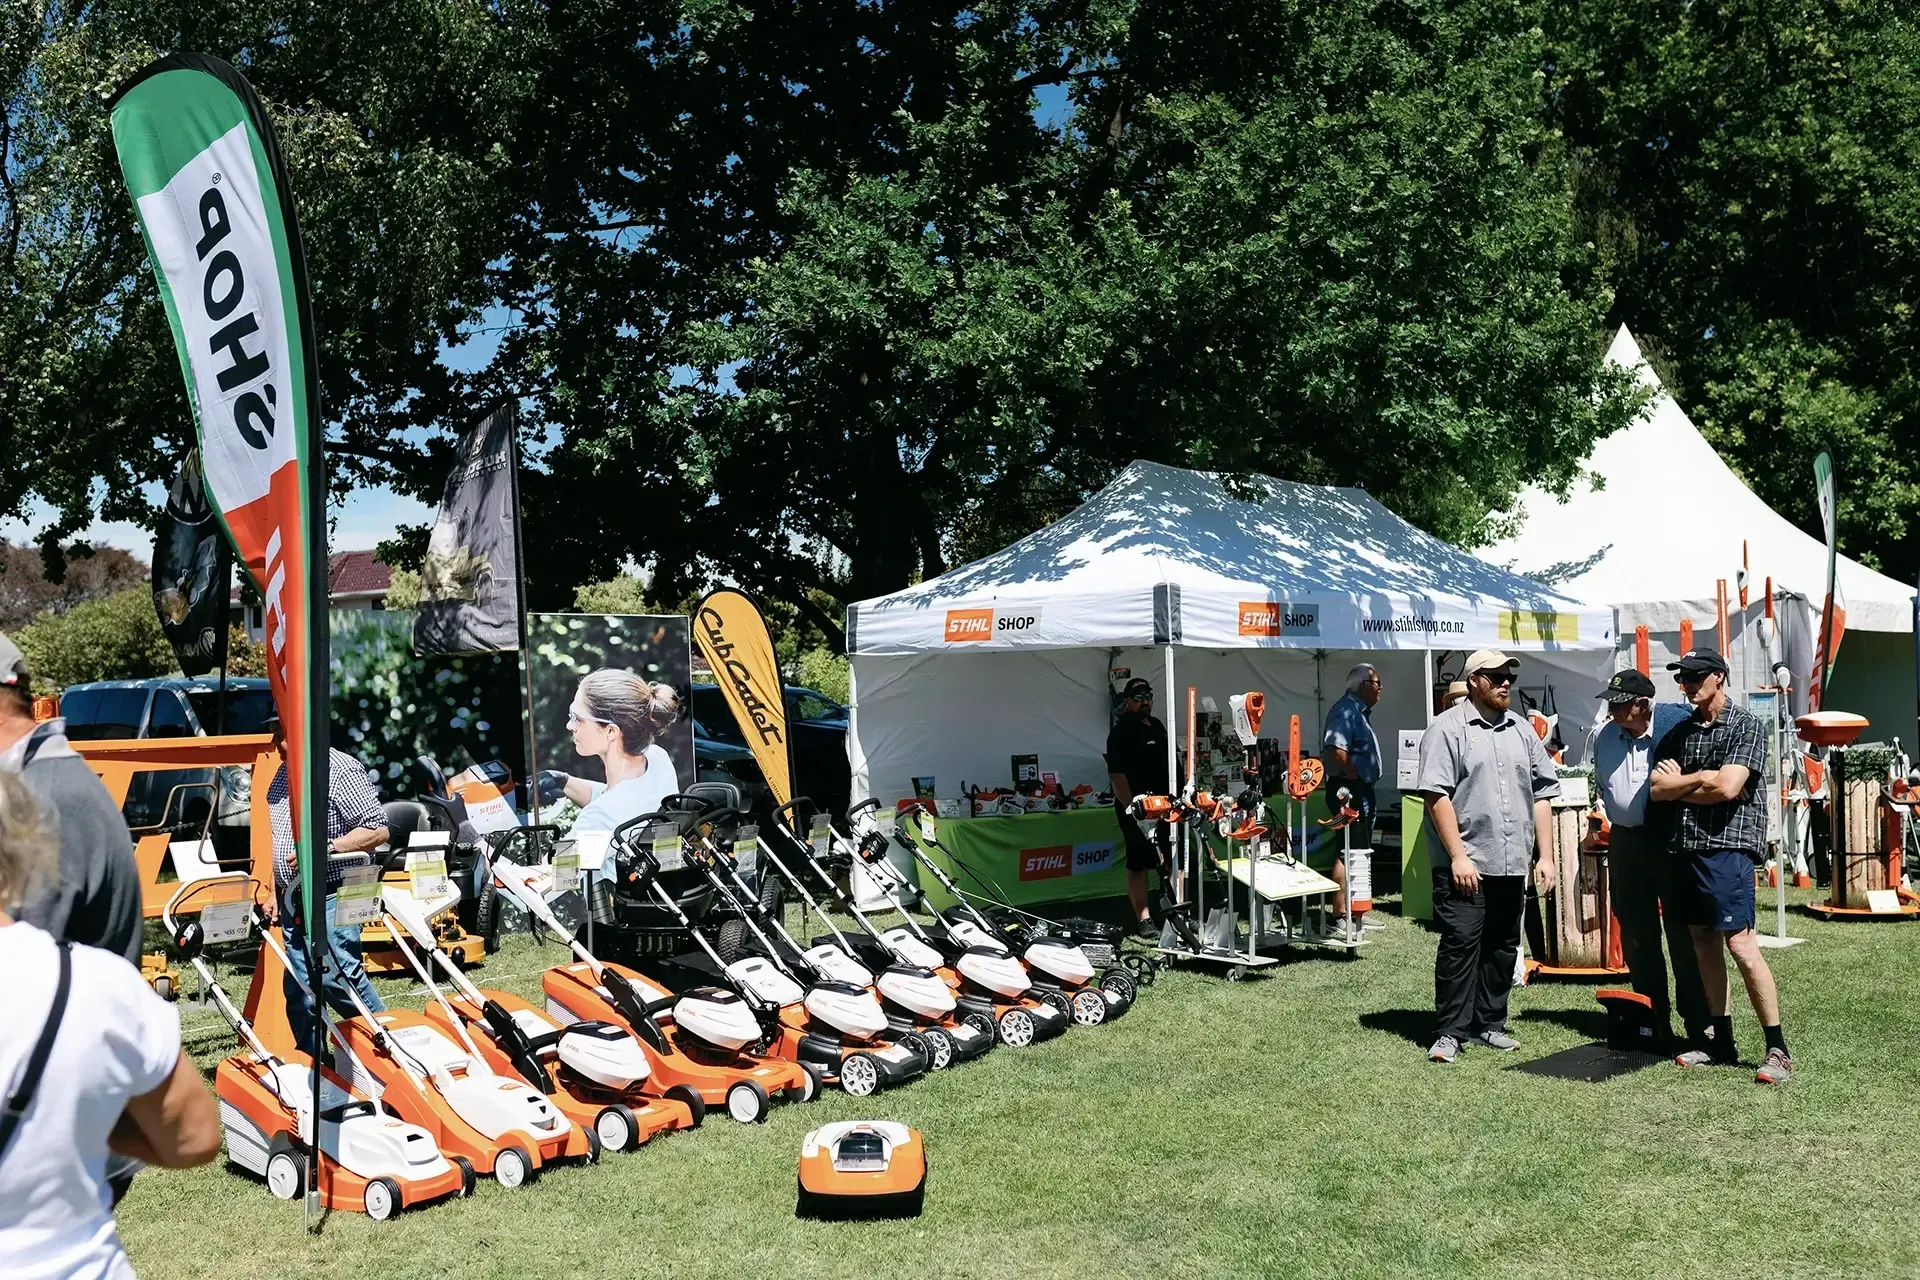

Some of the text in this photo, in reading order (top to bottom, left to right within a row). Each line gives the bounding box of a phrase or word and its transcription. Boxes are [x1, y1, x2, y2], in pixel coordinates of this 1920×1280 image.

[947, 616, 1035, 632] STIHL SHOP
[1241, 611, 1314, 627] STIHL SHOP
[1362, 615, 1465, 636] www.stihlshop.co.nz
[699, 606, 736, 660] Cub
[726, 659, 784, 747] Cadet
[1024, 849, 1110, 872] STIHL SHOP
